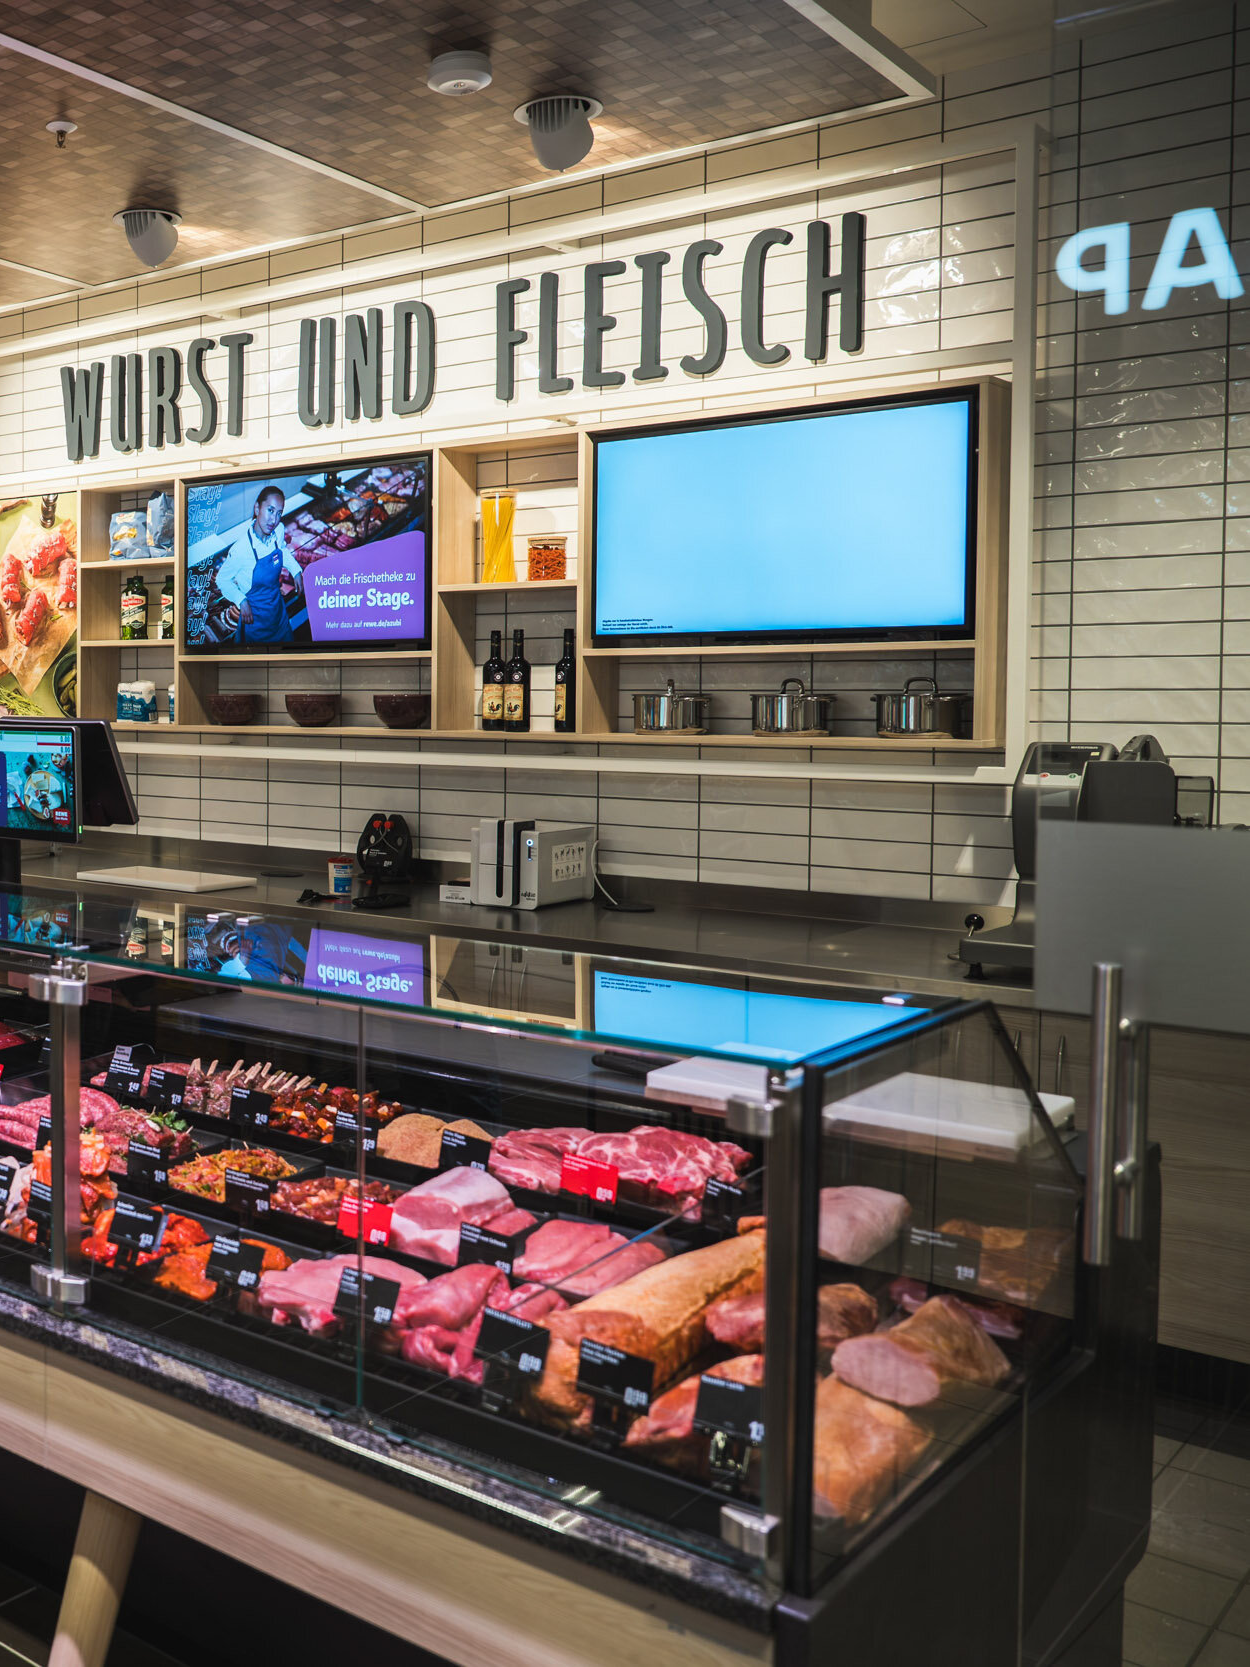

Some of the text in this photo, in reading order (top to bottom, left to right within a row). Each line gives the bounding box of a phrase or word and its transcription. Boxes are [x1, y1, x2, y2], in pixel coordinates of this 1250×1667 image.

[60, 211, 867, 461] WURST UND FLEISCH
[188, 502, 221, 527] Slay!
[314, 571, 416, 586] Mach die Frischetheke zu
[318, 588, 414, 611] deiner Stage.
[326, 619, 402, 629] Mehr dazu auf rewe.de/azubi
